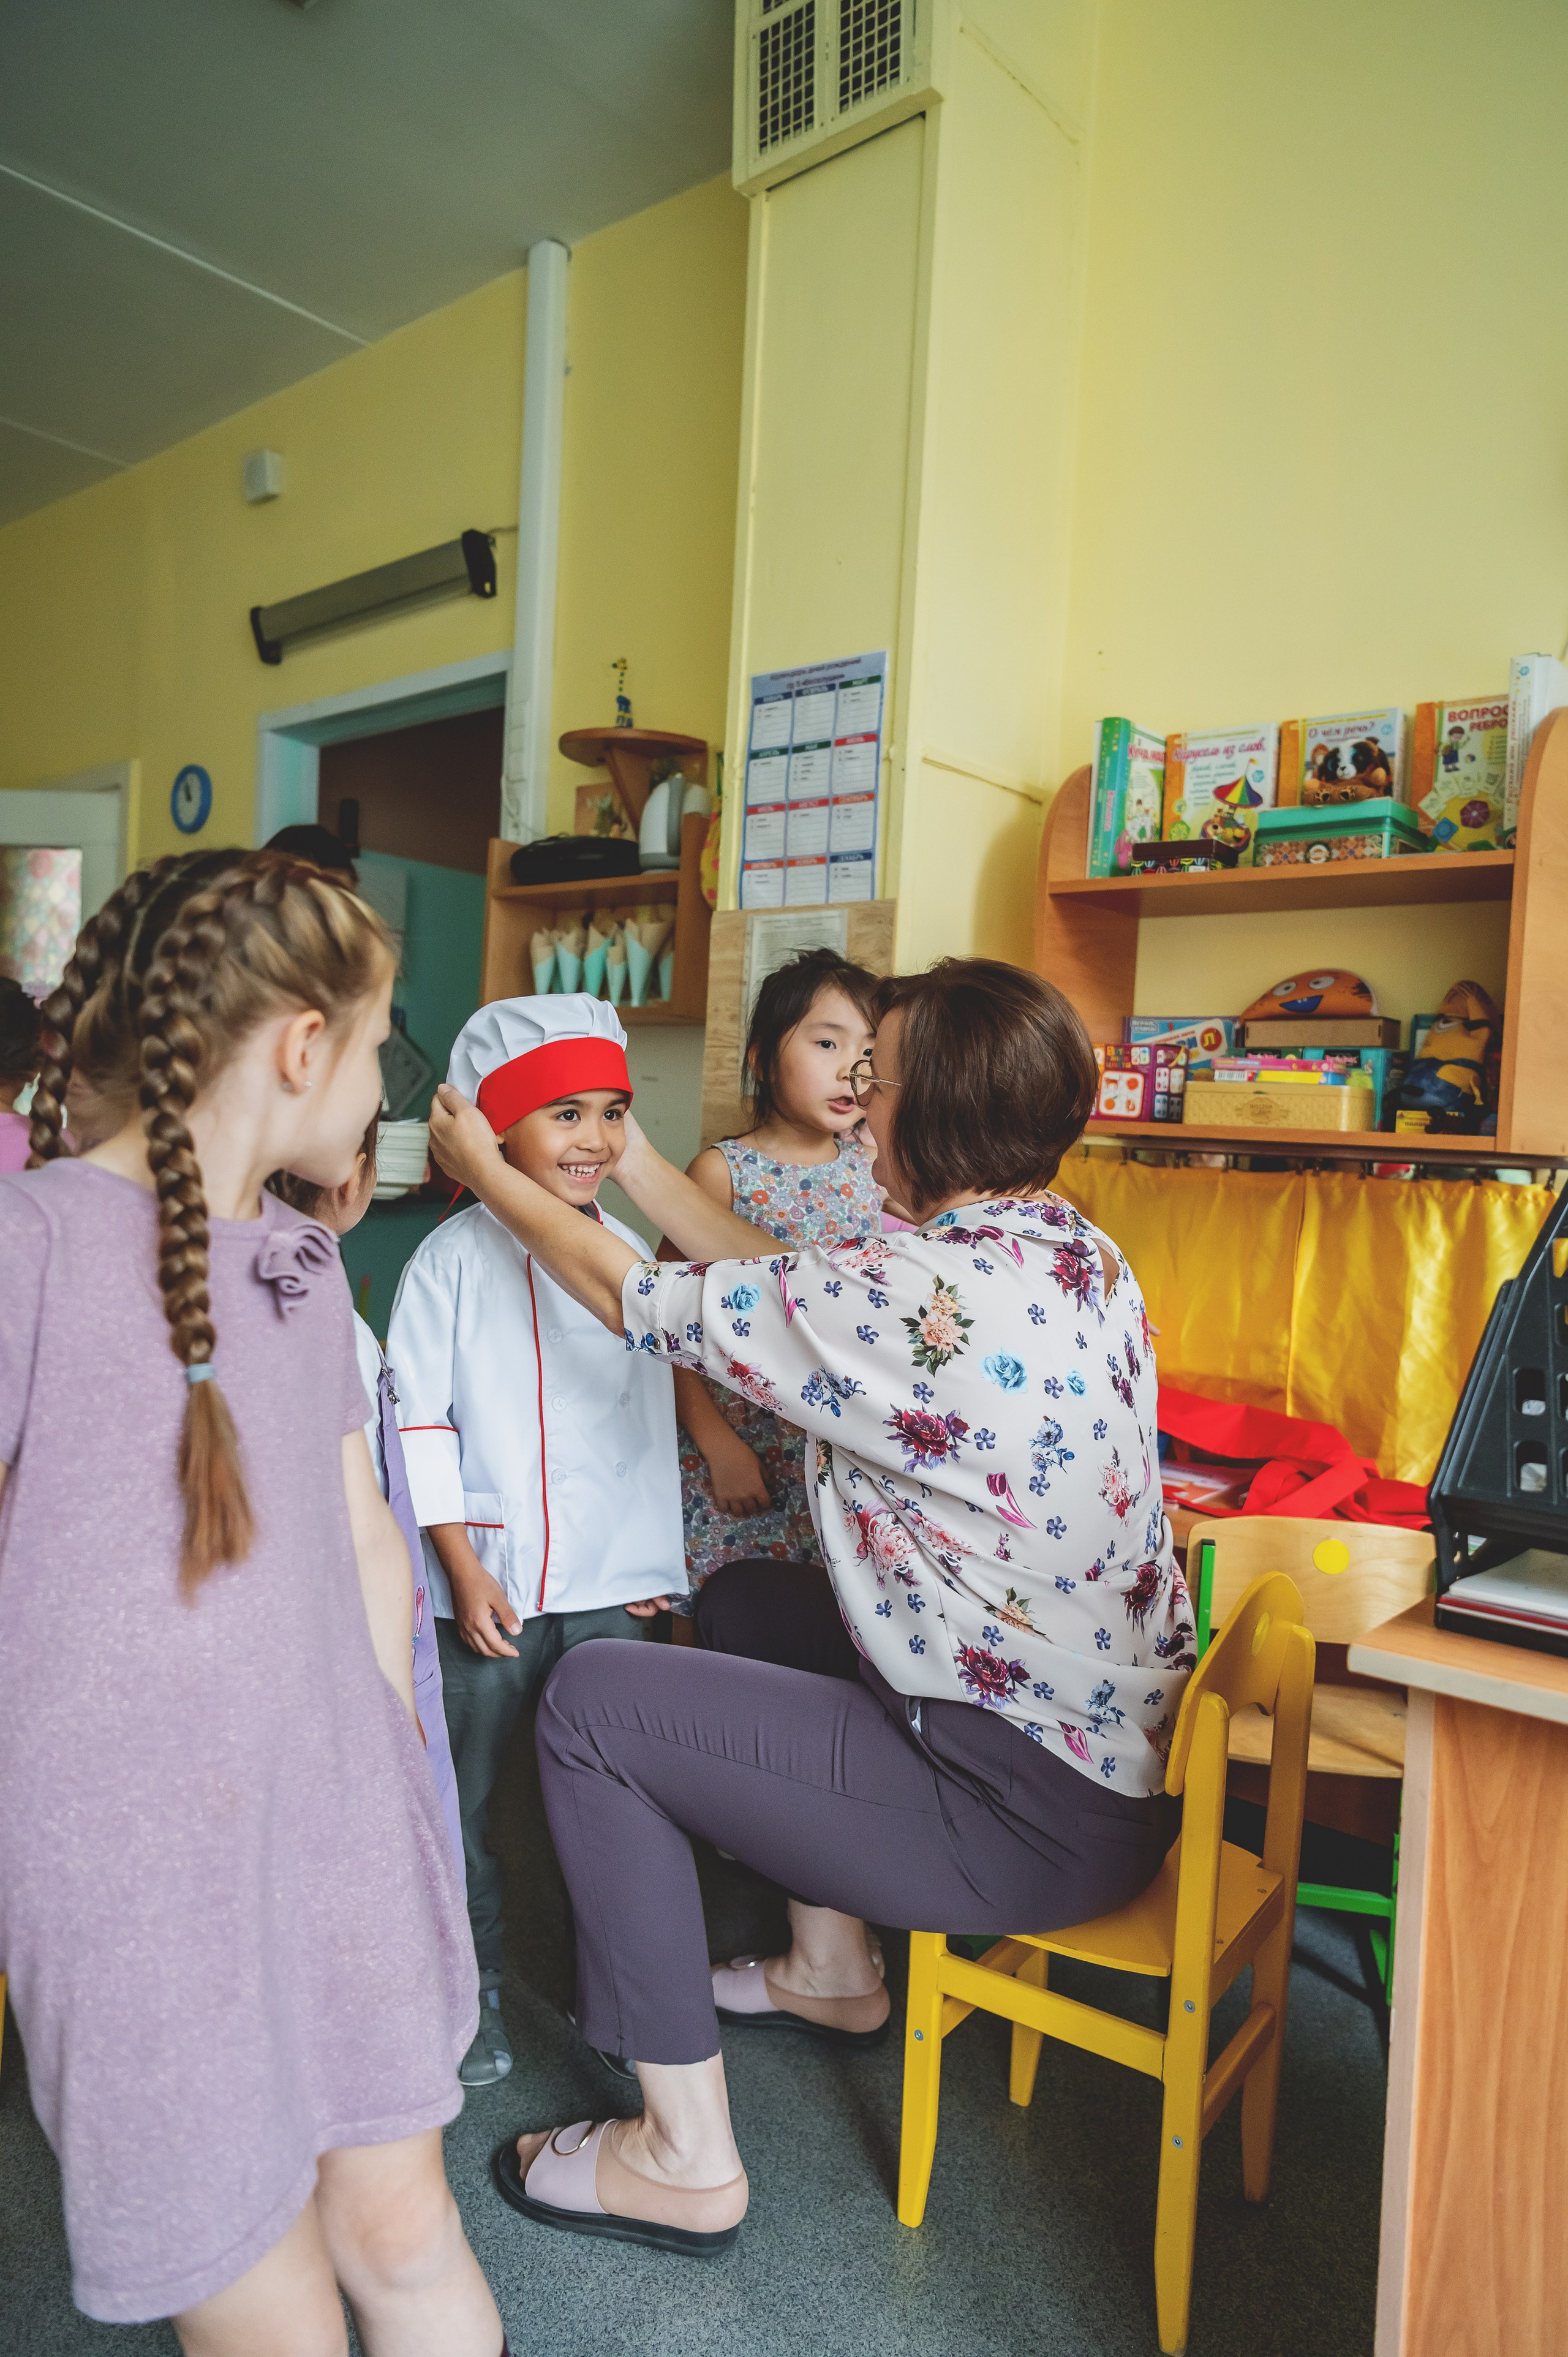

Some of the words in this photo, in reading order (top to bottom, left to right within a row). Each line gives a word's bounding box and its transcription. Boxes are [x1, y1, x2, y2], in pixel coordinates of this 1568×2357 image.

[1448, 704, 1508, 722] ВОПРОС
[1308, 727, 1317, 738] О
[1343, 721, 1375, 738] речь?
[1469, 718, 1508, 731] РЕБРО
[1172, 747, 1219, 764] Карусель
[1223, 745, 1235, 759] из
[1203, 1032, 1215, 1047] Л
